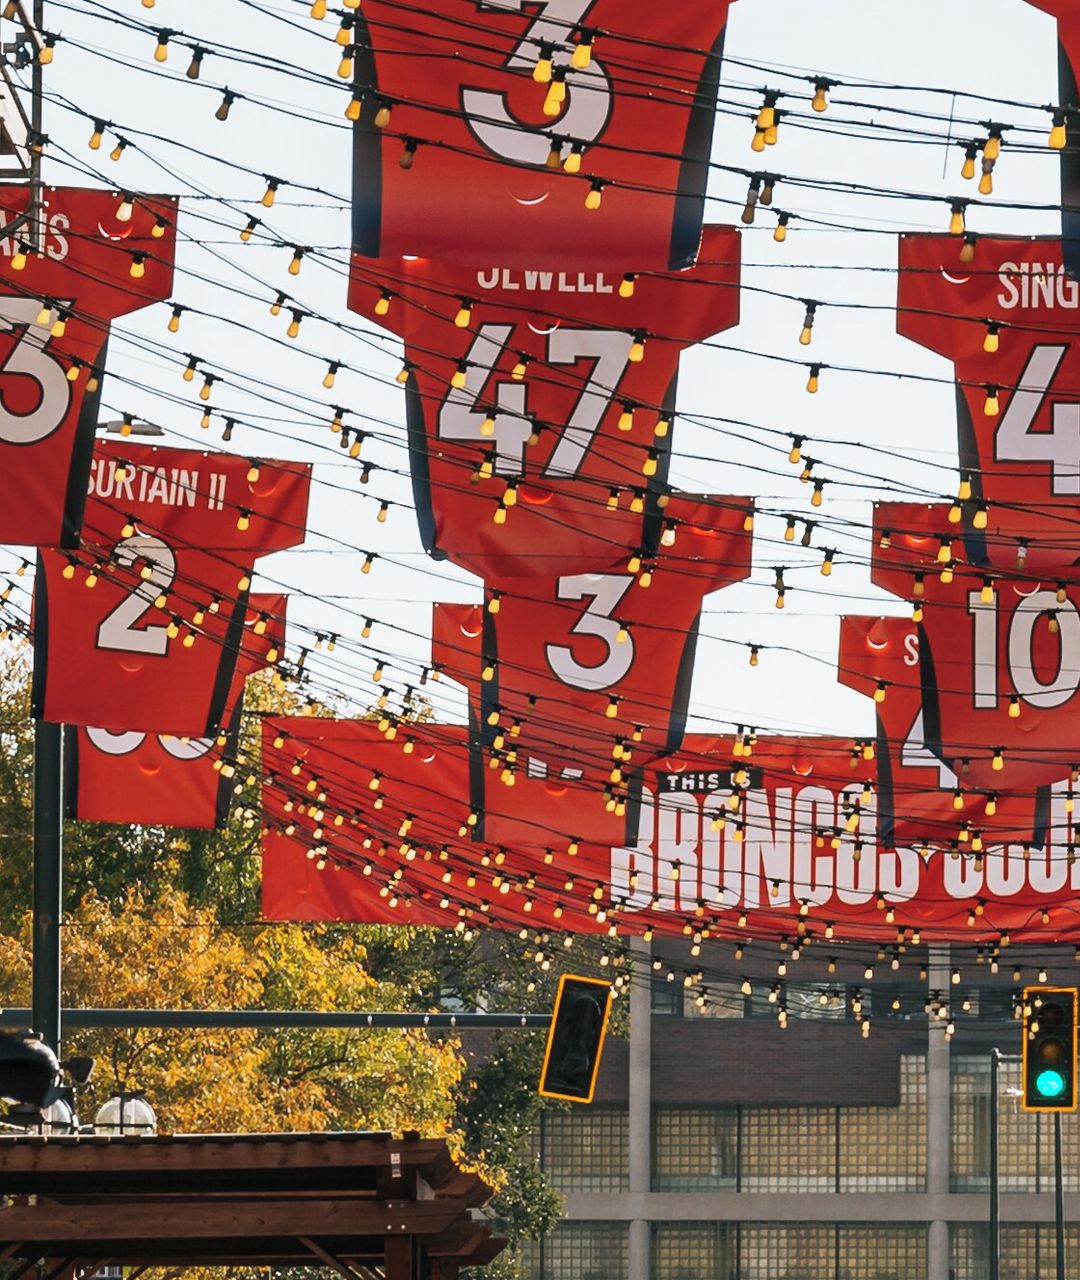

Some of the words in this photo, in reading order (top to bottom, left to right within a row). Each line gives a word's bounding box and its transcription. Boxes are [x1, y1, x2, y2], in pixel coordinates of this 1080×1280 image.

[436, 322, 640, 478] 47
[97, 535, 177, 657] 2
[545, 573, 636, 691] 3
[666, 773, 719, 791] THIS
